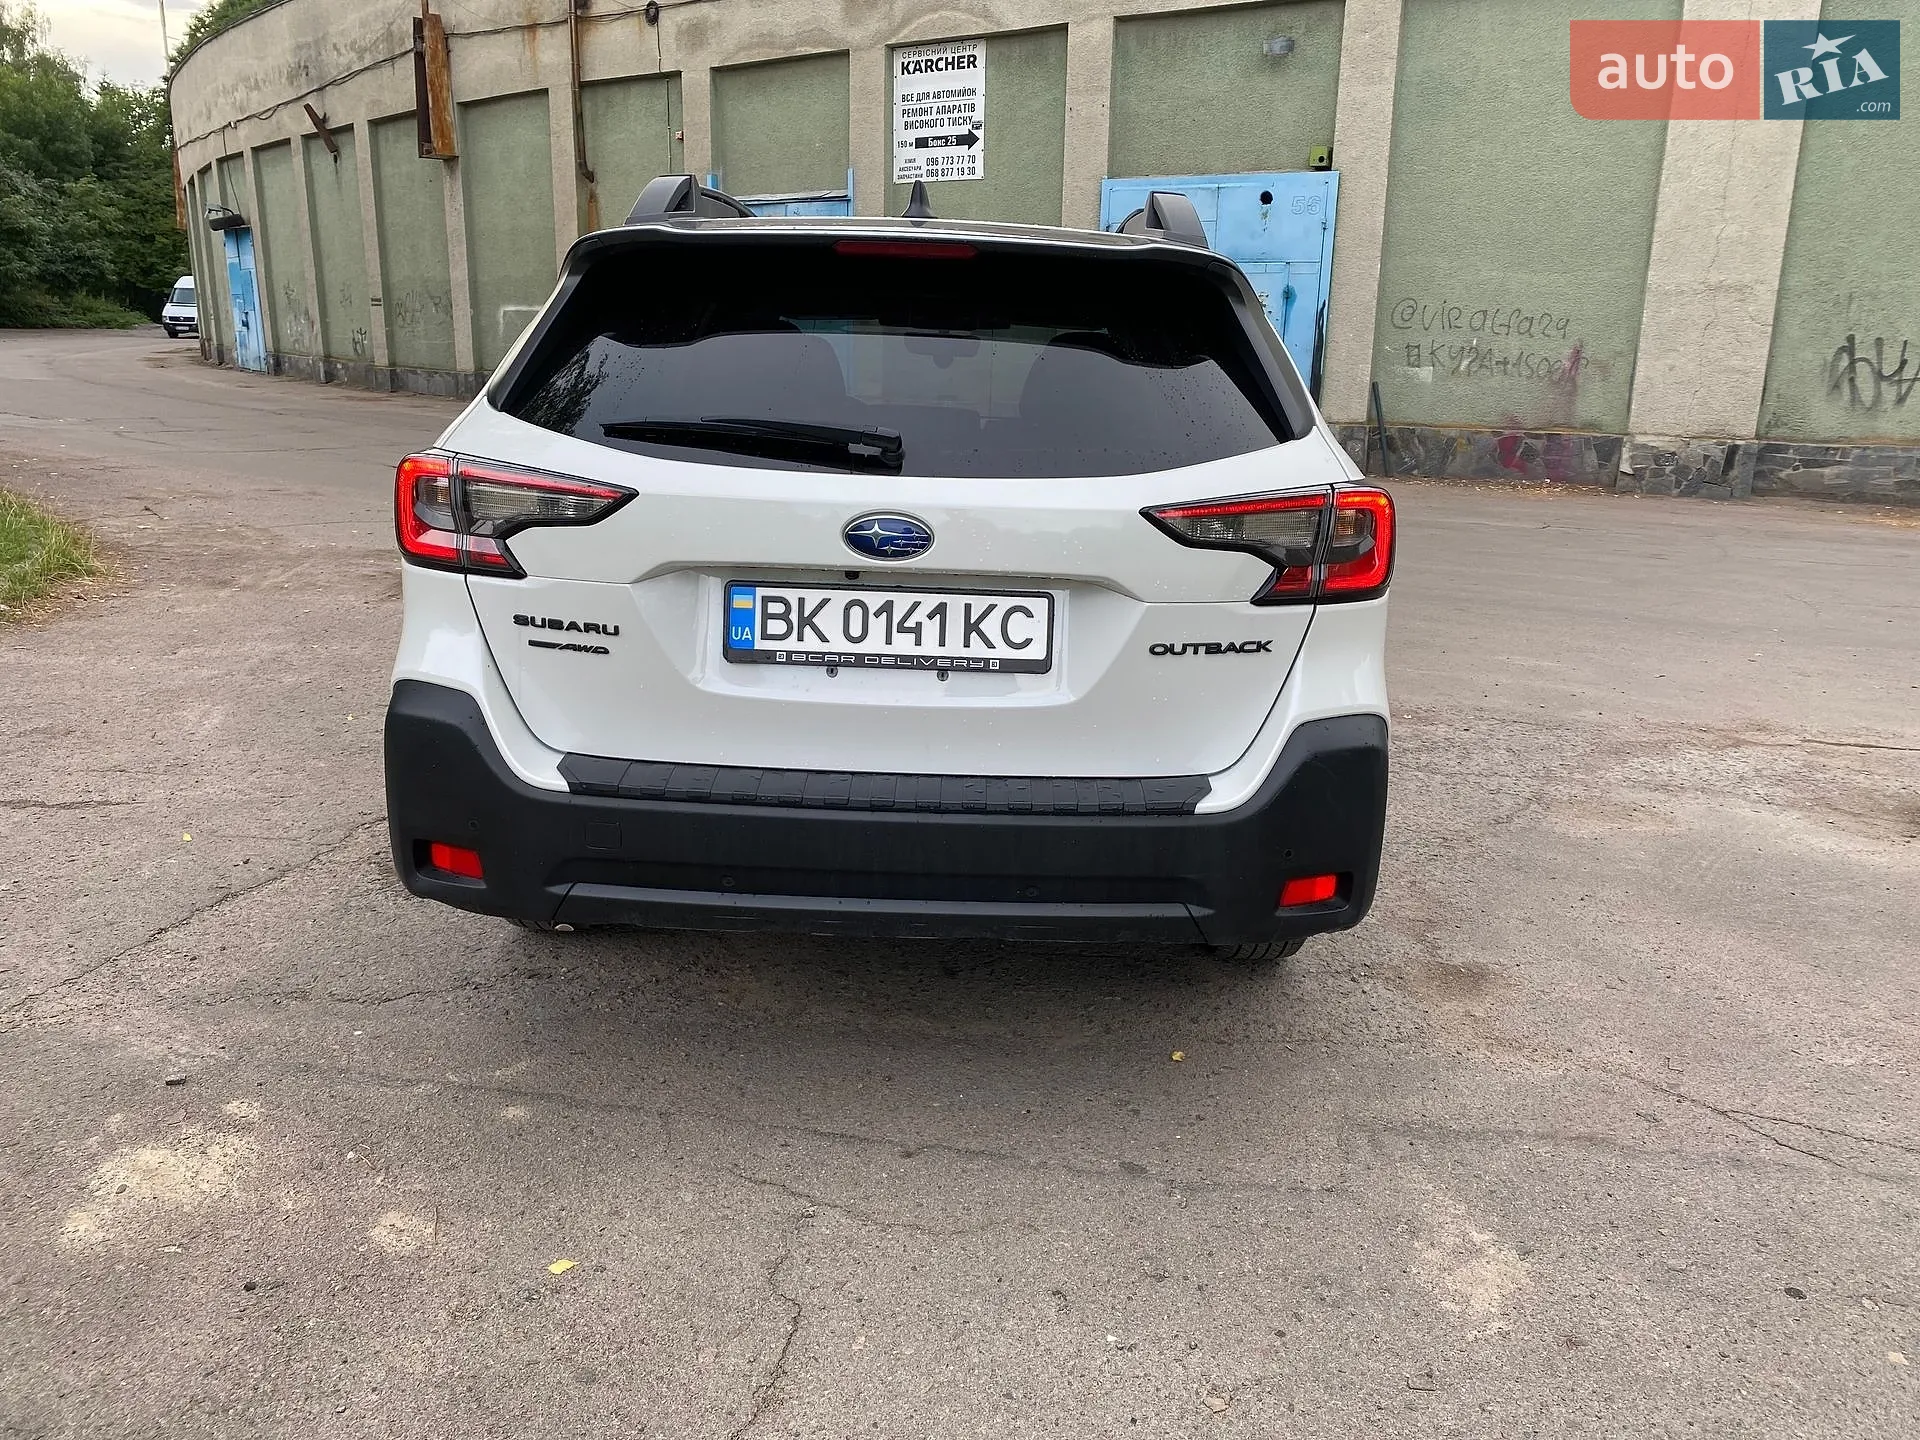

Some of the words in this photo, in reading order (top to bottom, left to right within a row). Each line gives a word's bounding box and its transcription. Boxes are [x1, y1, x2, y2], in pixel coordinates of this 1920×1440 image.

[902, 46, 948, 59] СЕРВІСНИЙ
[951, 44, 978, 56] ЦЕНТР
[901, 54, 978, 76] KÄRCHER
[902, 93, 915, 103] ВСЕ
[916, 91, 931, 103] ДЛЯ
[932, 87, 977, 100] АВТОМИЙОК
[902, 106, 933, 118] РЕМОНТ
[936, 102, 976, 115] АПАРАТІВ
[904, 119, 945, 131] ВИСОКОГО
[947, 116, 973, 127] ТИСКУ
[897, 140, 907, 149] 150
[928, 137, 946, 147] Бокс
[947, 136, 957, 146] 25
[926, 157, 939, 167] 096
[941, 156, 955, 166] 773
[956, 156, 965, 165] 77
[967, 155, 976, 164] 70
[926, 168, 939, 178] 068
[941, 168, 955, 178] 877
[957, 168, 965, 177] 19
[967, 167, 976, 176] 30
[1291, 195, 1322, 215] 56
[513, 614, 620, 636] SUBARU
[760, 595, 831, 643] BK
[842, 598, 948, 647] 0141
[962, 602, 1035, 651] KC
[731, 626, 753, 641] UA
[558, 643, 610, 655] AWD
[1148, 640, 1274, 656] OUTBACK
[792, 653, 856, 664] BCAR
[864, 656, 985, 668] DELIVERY
